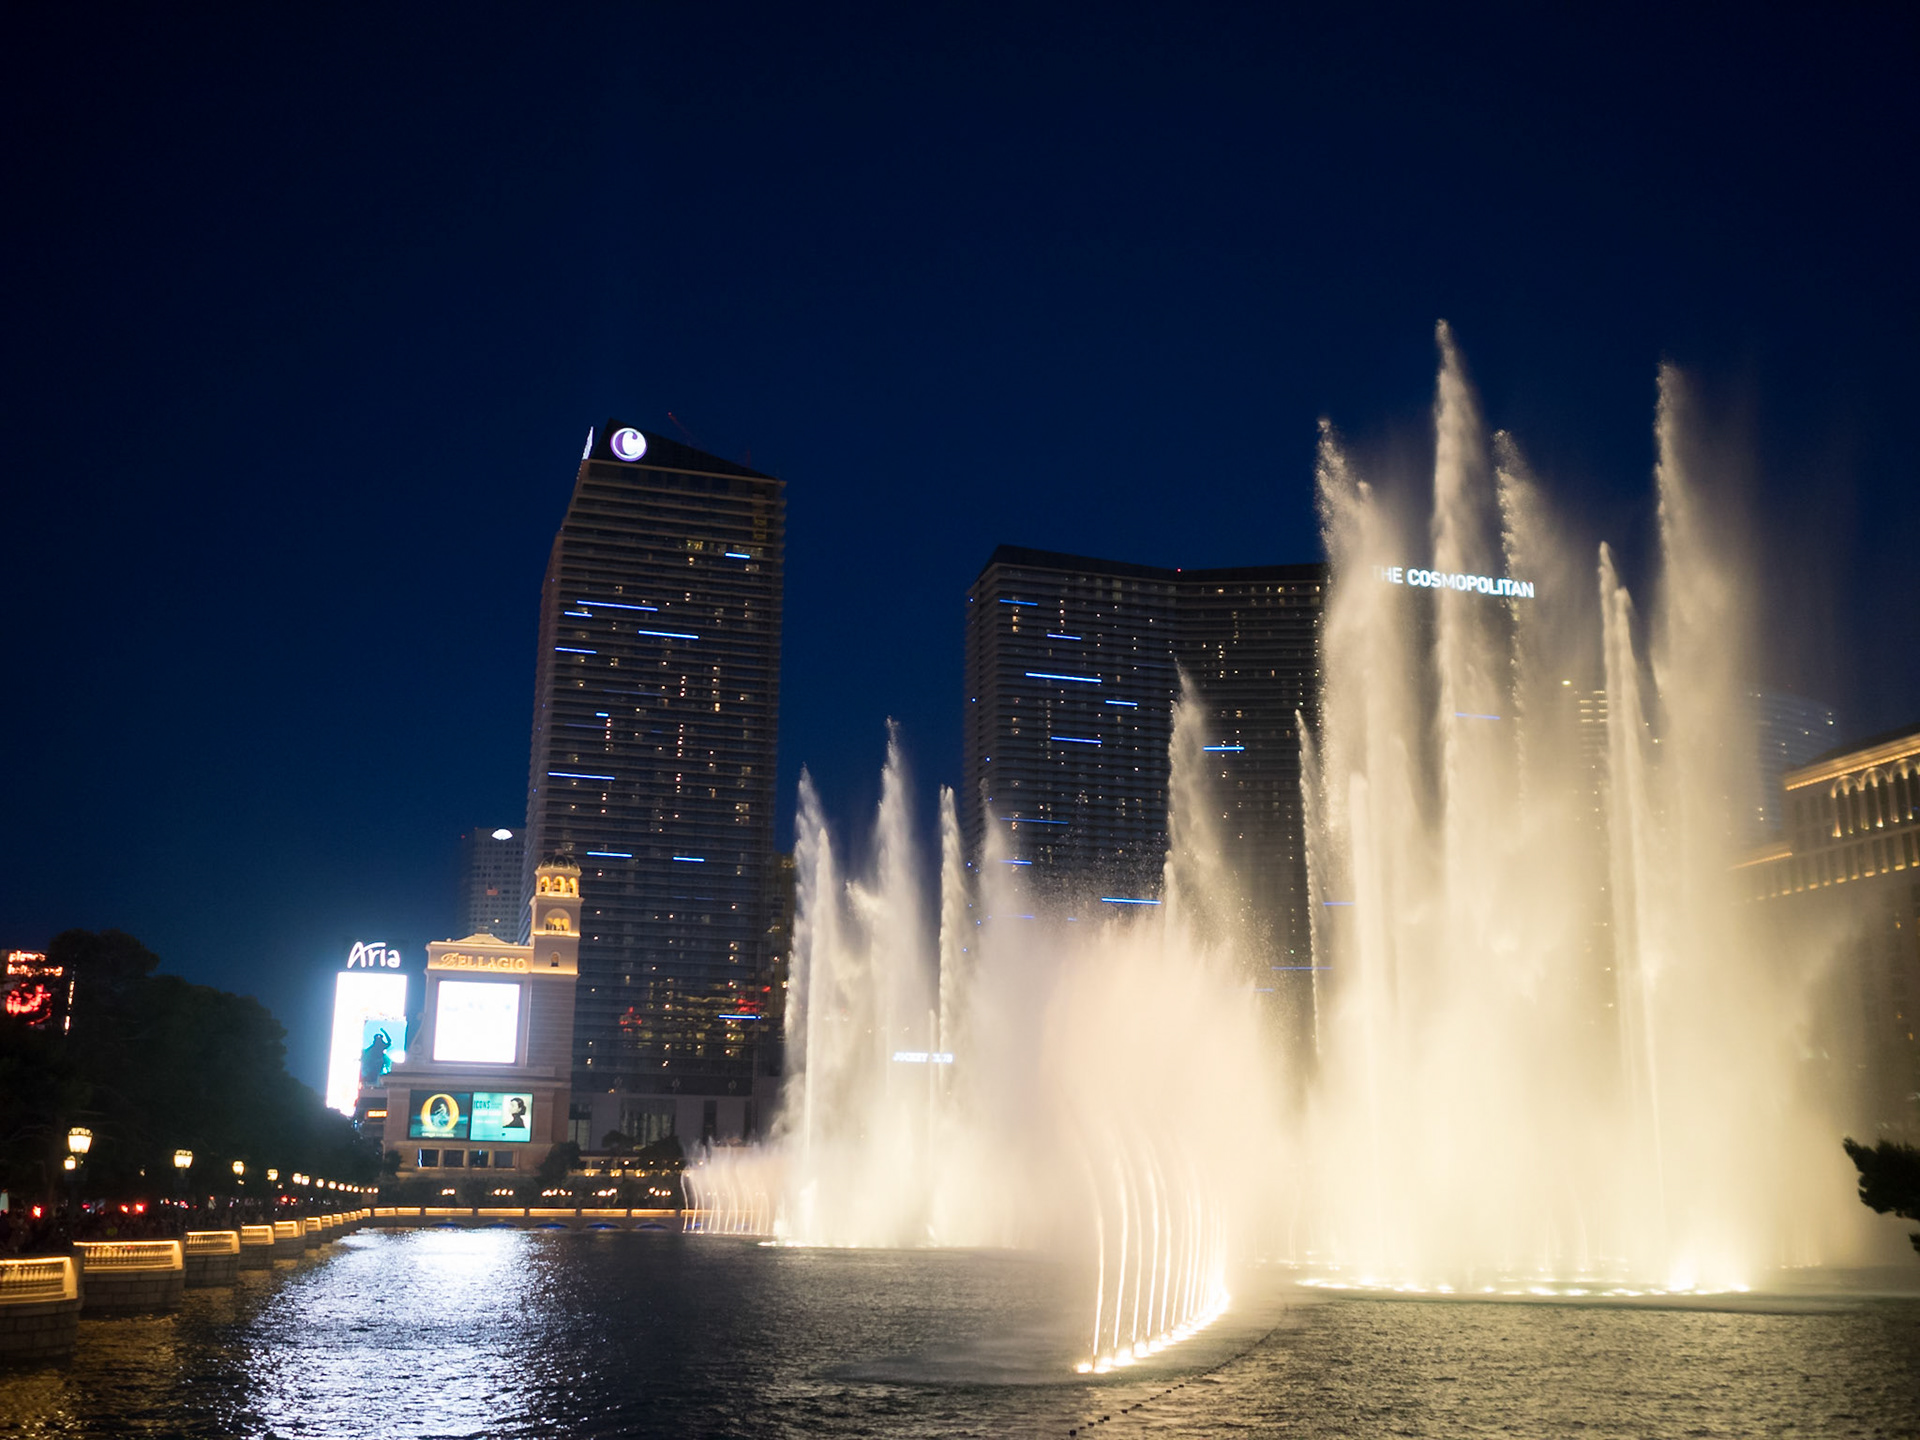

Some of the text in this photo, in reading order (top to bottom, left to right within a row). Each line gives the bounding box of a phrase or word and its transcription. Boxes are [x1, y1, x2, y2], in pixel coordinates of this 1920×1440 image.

[1407, 568, 1535, 598] COSMOPOLITAN
[347, 941, 401, 969] Aria
[440, 952, 527, 970] BELLAGIO
[421, 1093, 460, 1133] O
